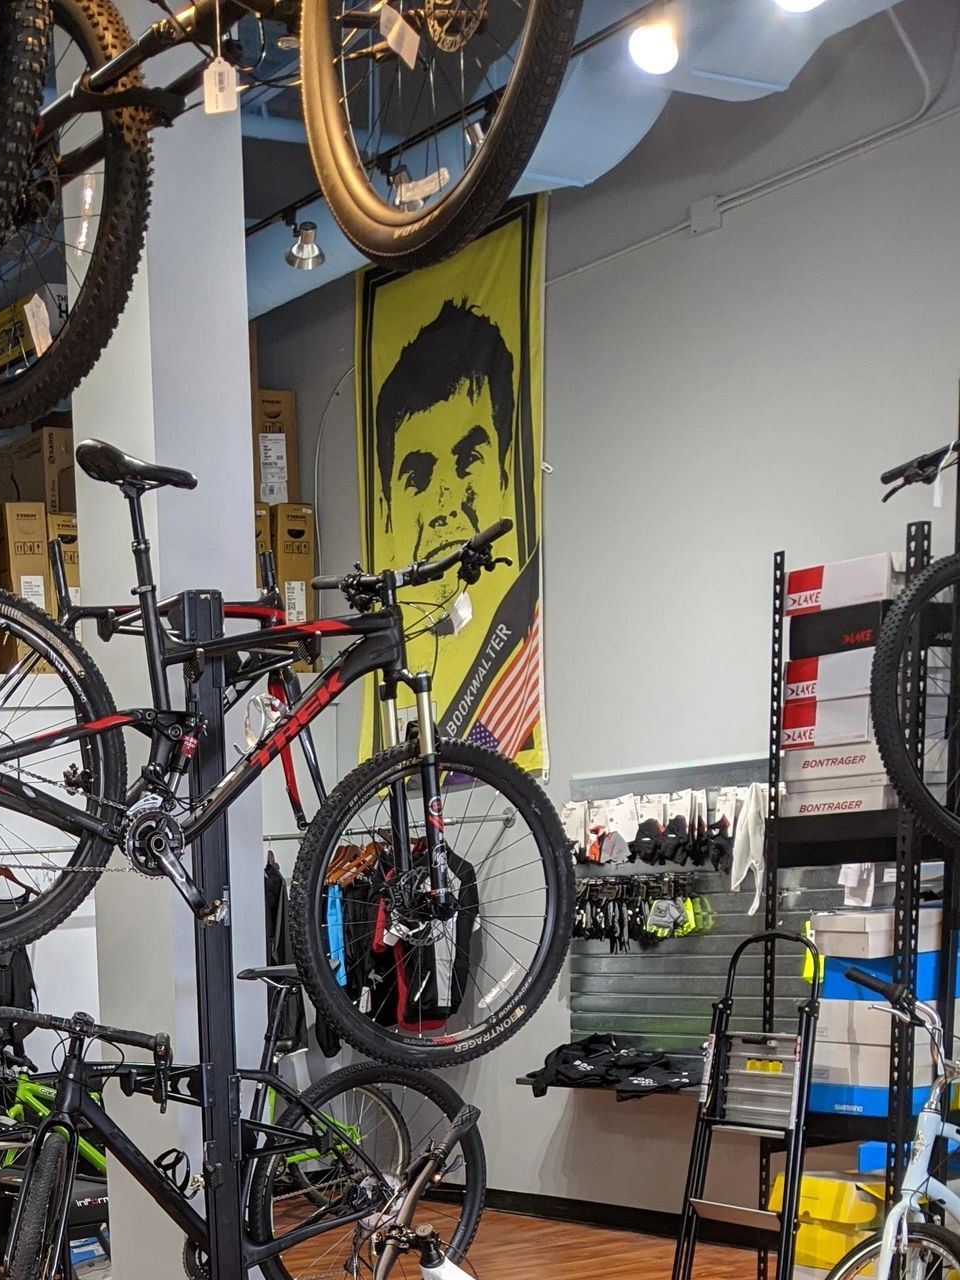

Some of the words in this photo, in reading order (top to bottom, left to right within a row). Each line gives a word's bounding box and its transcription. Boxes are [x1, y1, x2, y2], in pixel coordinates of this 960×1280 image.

[797, 591, 821, 606] LAKE
[850, 629, 873, 644] LAKE
[446, 623, 512, 736] BOOKWALTER
[795, 683, 817, 696] LAKE
[248, 670, 345, 768] TREK
[791, 728, 815, 742] LAKE
[801, 755, 866, 769] BONTRAGER
[798, 800, 862, 813] BONTRAGER
[498, 976, 533, 1018] BONTRAGER
[454, 1012, 520, 1053] BONTRAGER
